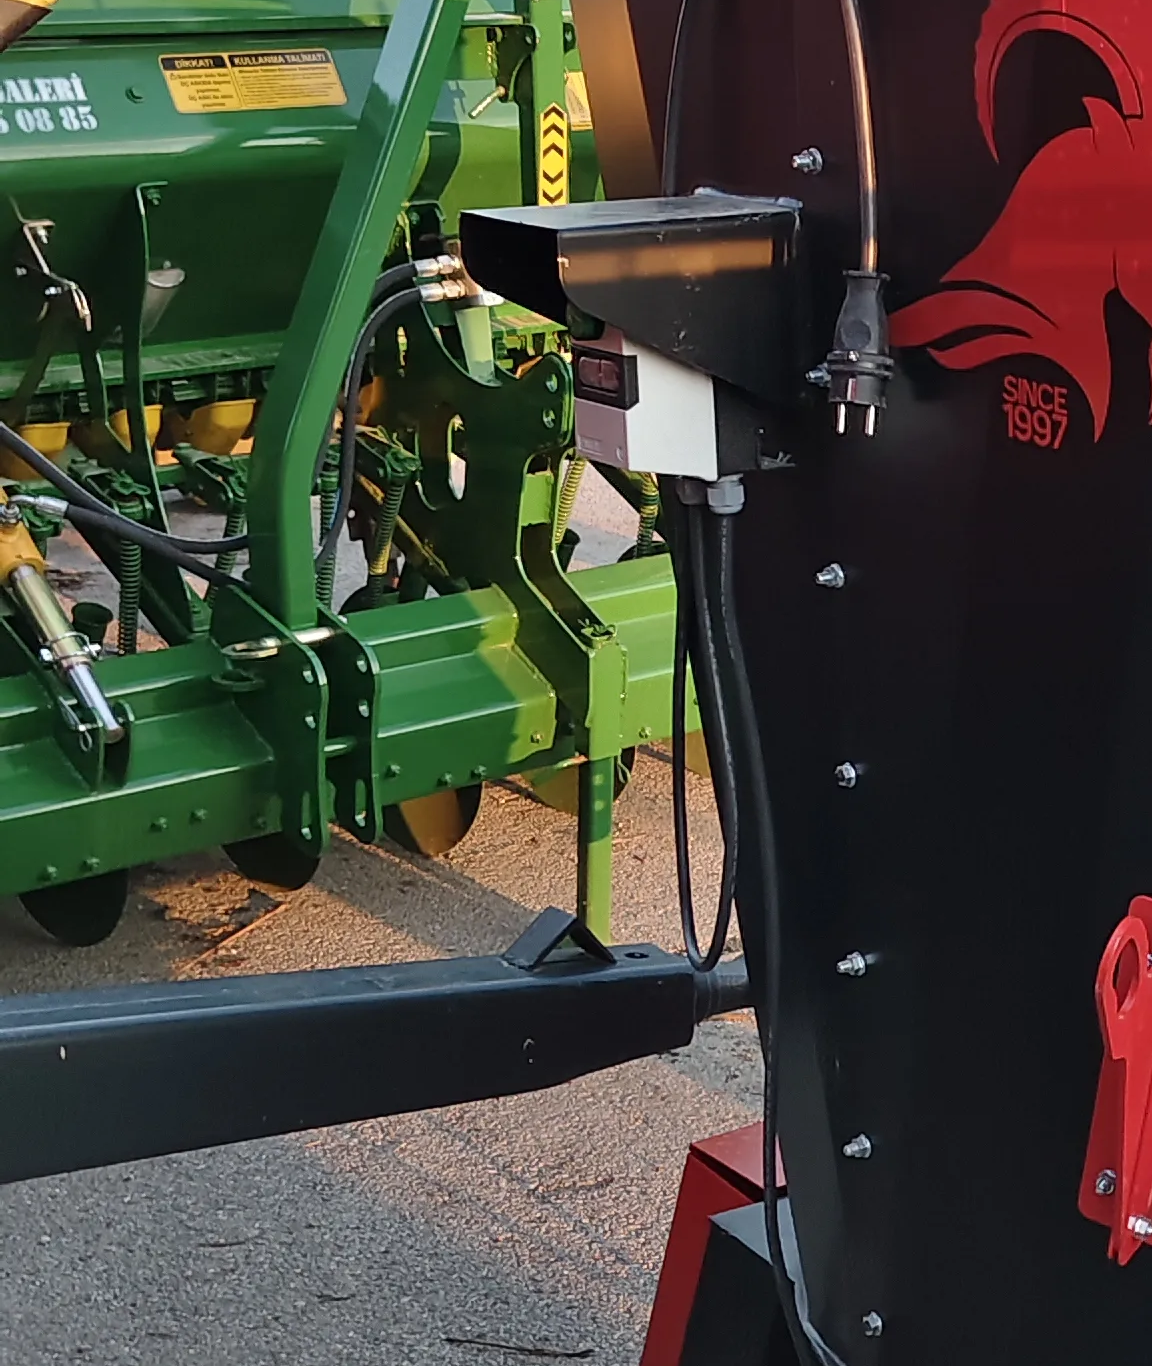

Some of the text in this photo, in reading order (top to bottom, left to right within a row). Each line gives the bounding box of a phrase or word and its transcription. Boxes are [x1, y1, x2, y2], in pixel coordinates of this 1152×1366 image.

[14, 106, 55, 134] 08
[59, 105, 98, 132] 85
[1002, 375, 1068, 415] SINCE
[1002, 403, 1068, 450] 1997
